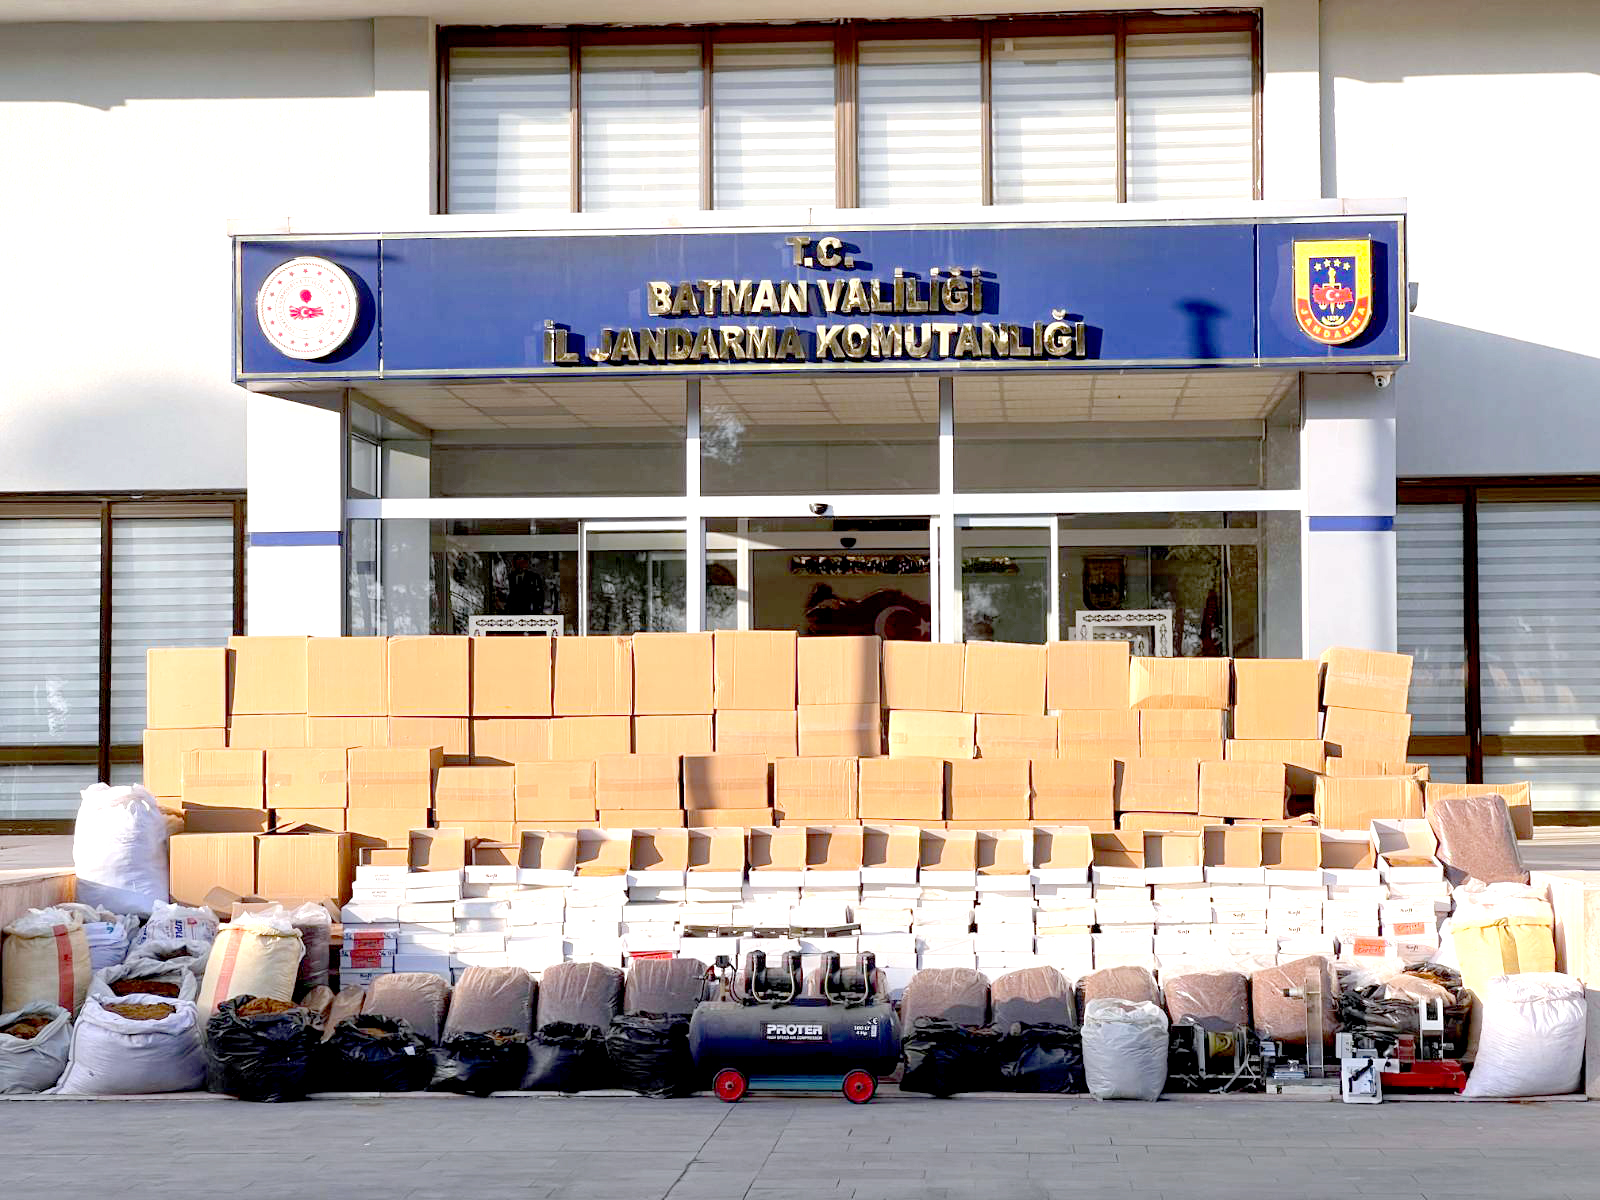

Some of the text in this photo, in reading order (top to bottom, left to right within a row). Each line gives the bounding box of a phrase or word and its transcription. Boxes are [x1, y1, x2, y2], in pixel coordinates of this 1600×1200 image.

[785, 237, 854, 268] T.C.
[648, 267, 983, 316] BATMAN VALİLİĞİ
[544, 308, 1086, 363] İL JANDARMA KOMUTANLIĞI
[1300, 307, 1366, 338] JANDARMA
[766, 1024, 823, 1035] PROTER
